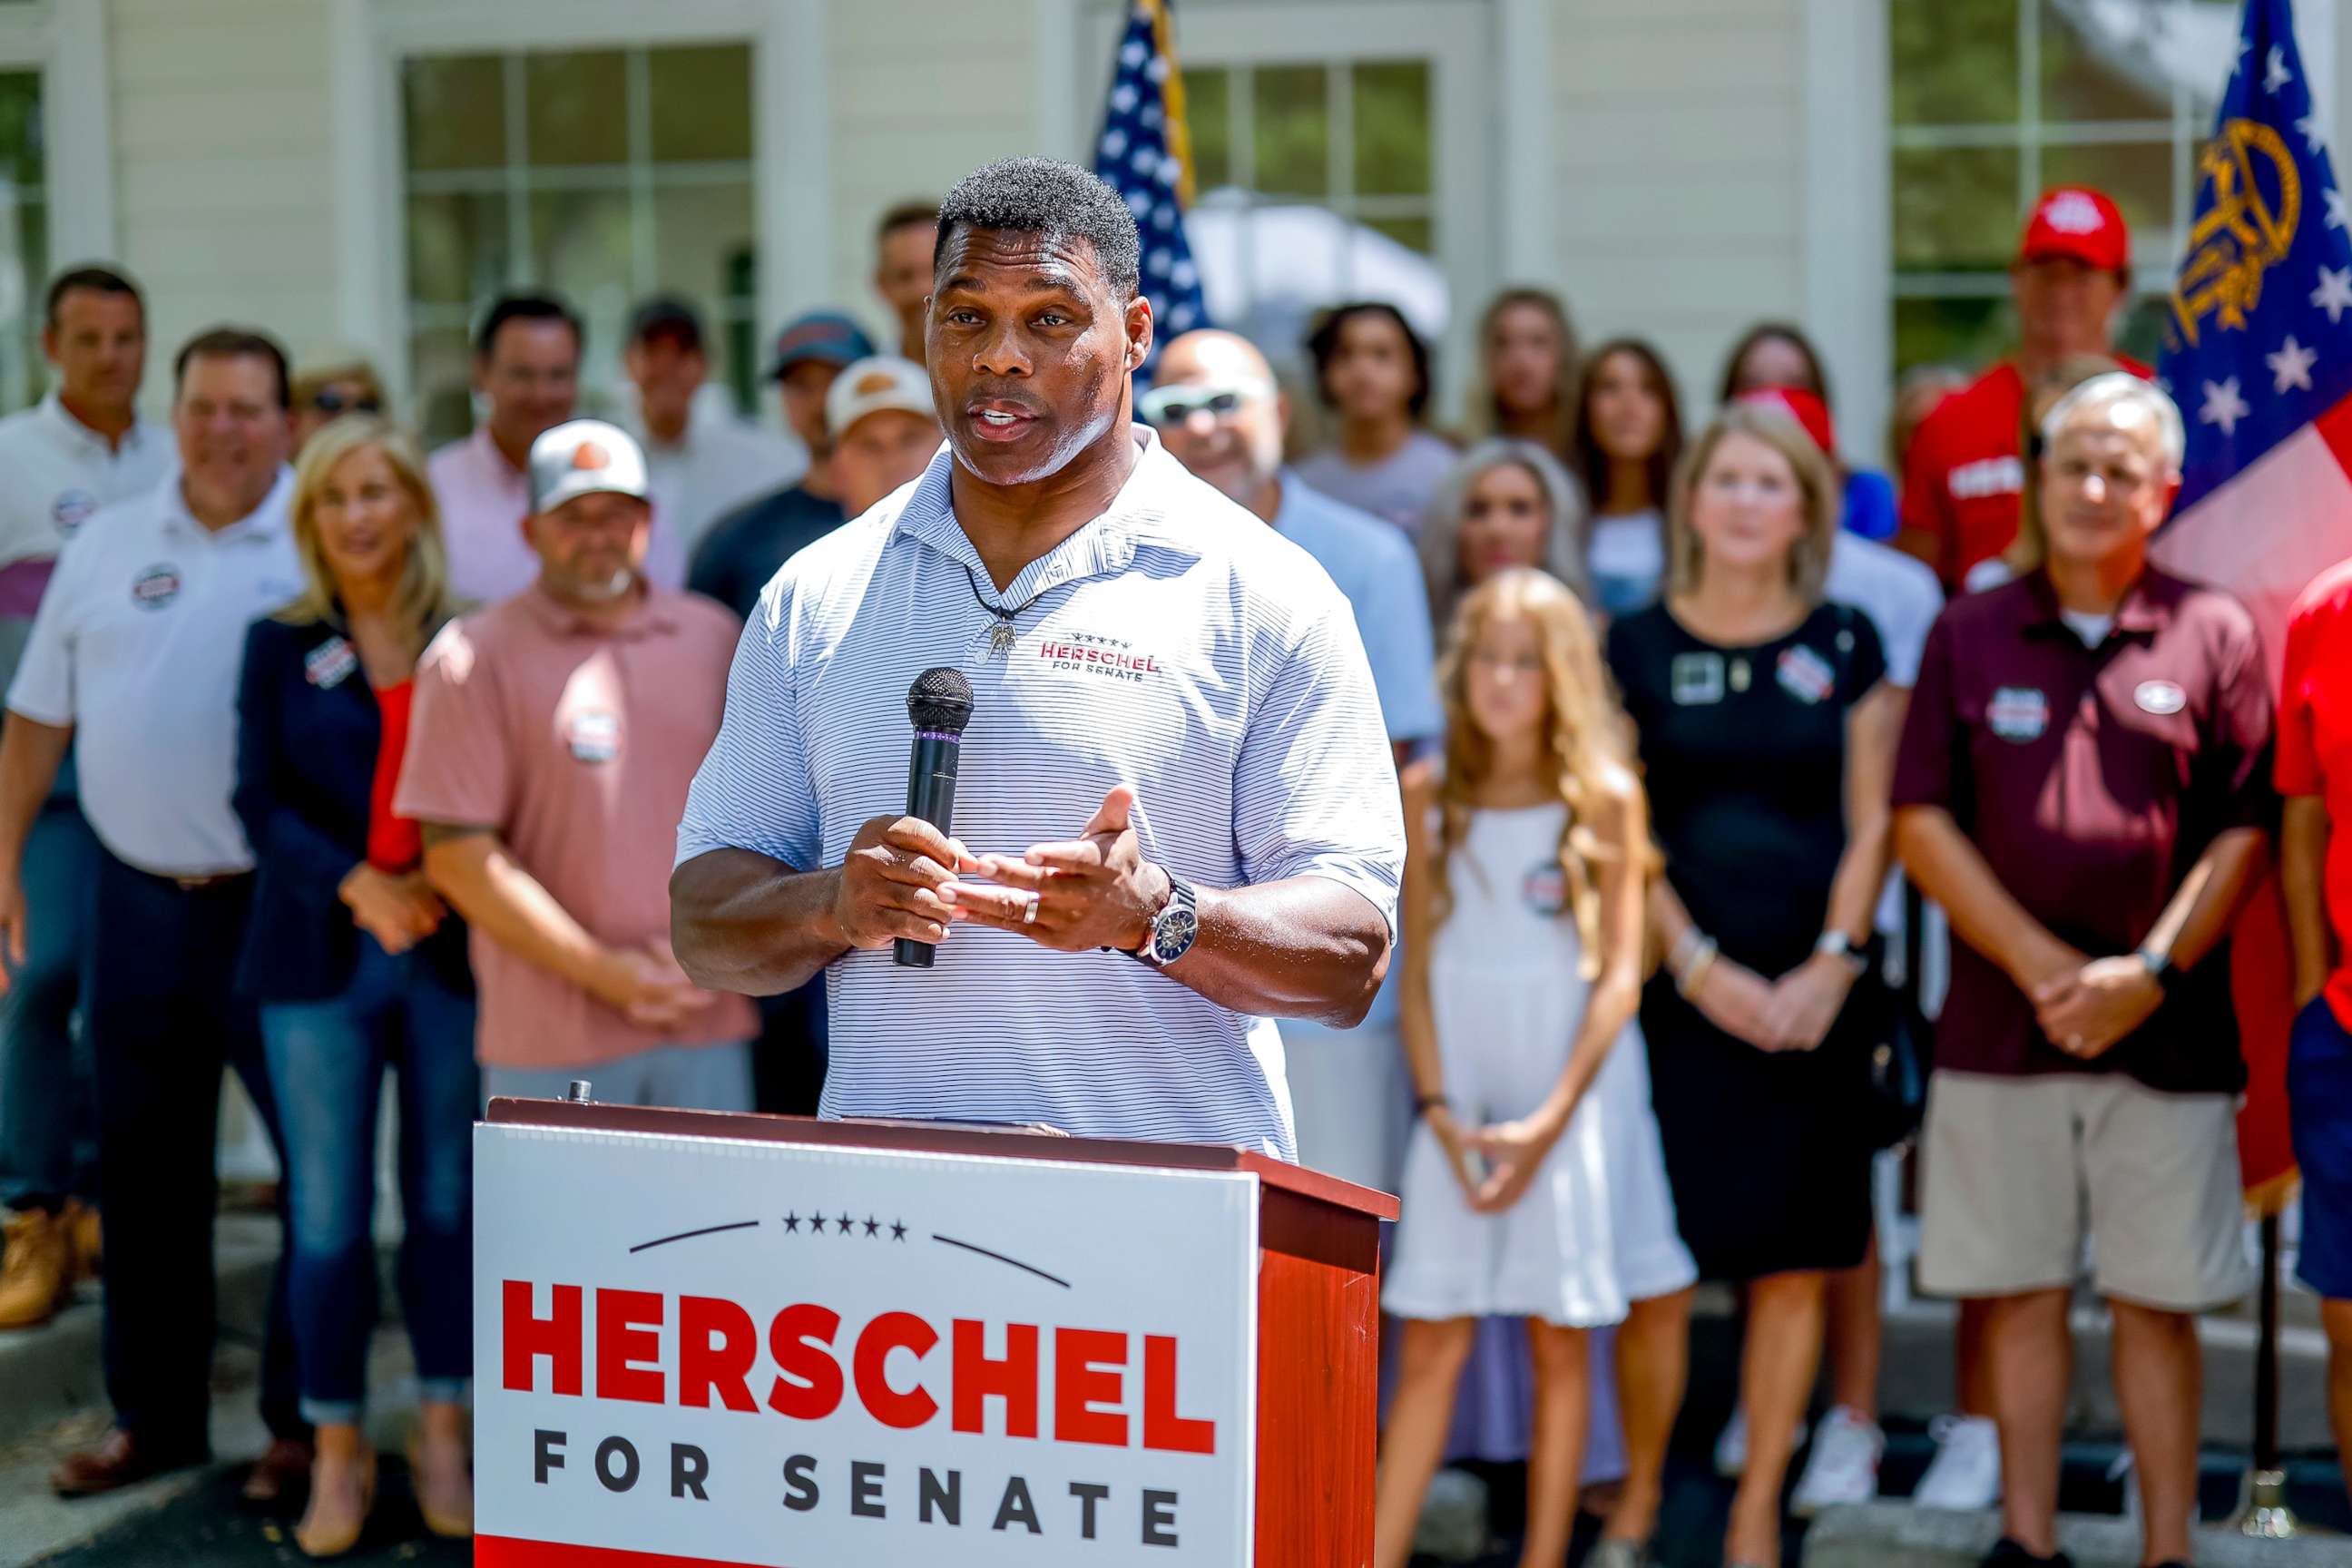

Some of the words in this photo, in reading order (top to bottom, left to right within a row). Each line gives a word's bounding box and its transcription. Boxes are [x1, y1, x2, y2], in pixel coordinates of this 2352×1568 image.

[1040, 641, 1160, 672] HERSCHEL
[1053, 661, 1081, 671] FOR
[1085, 664, 1143, 682] SENATE
[502, 1279, 1216, 1455] HERSCHEL
[533, 1427, 710, 1502] FOR
[781, 1453, 1180, 1548] SENATE
